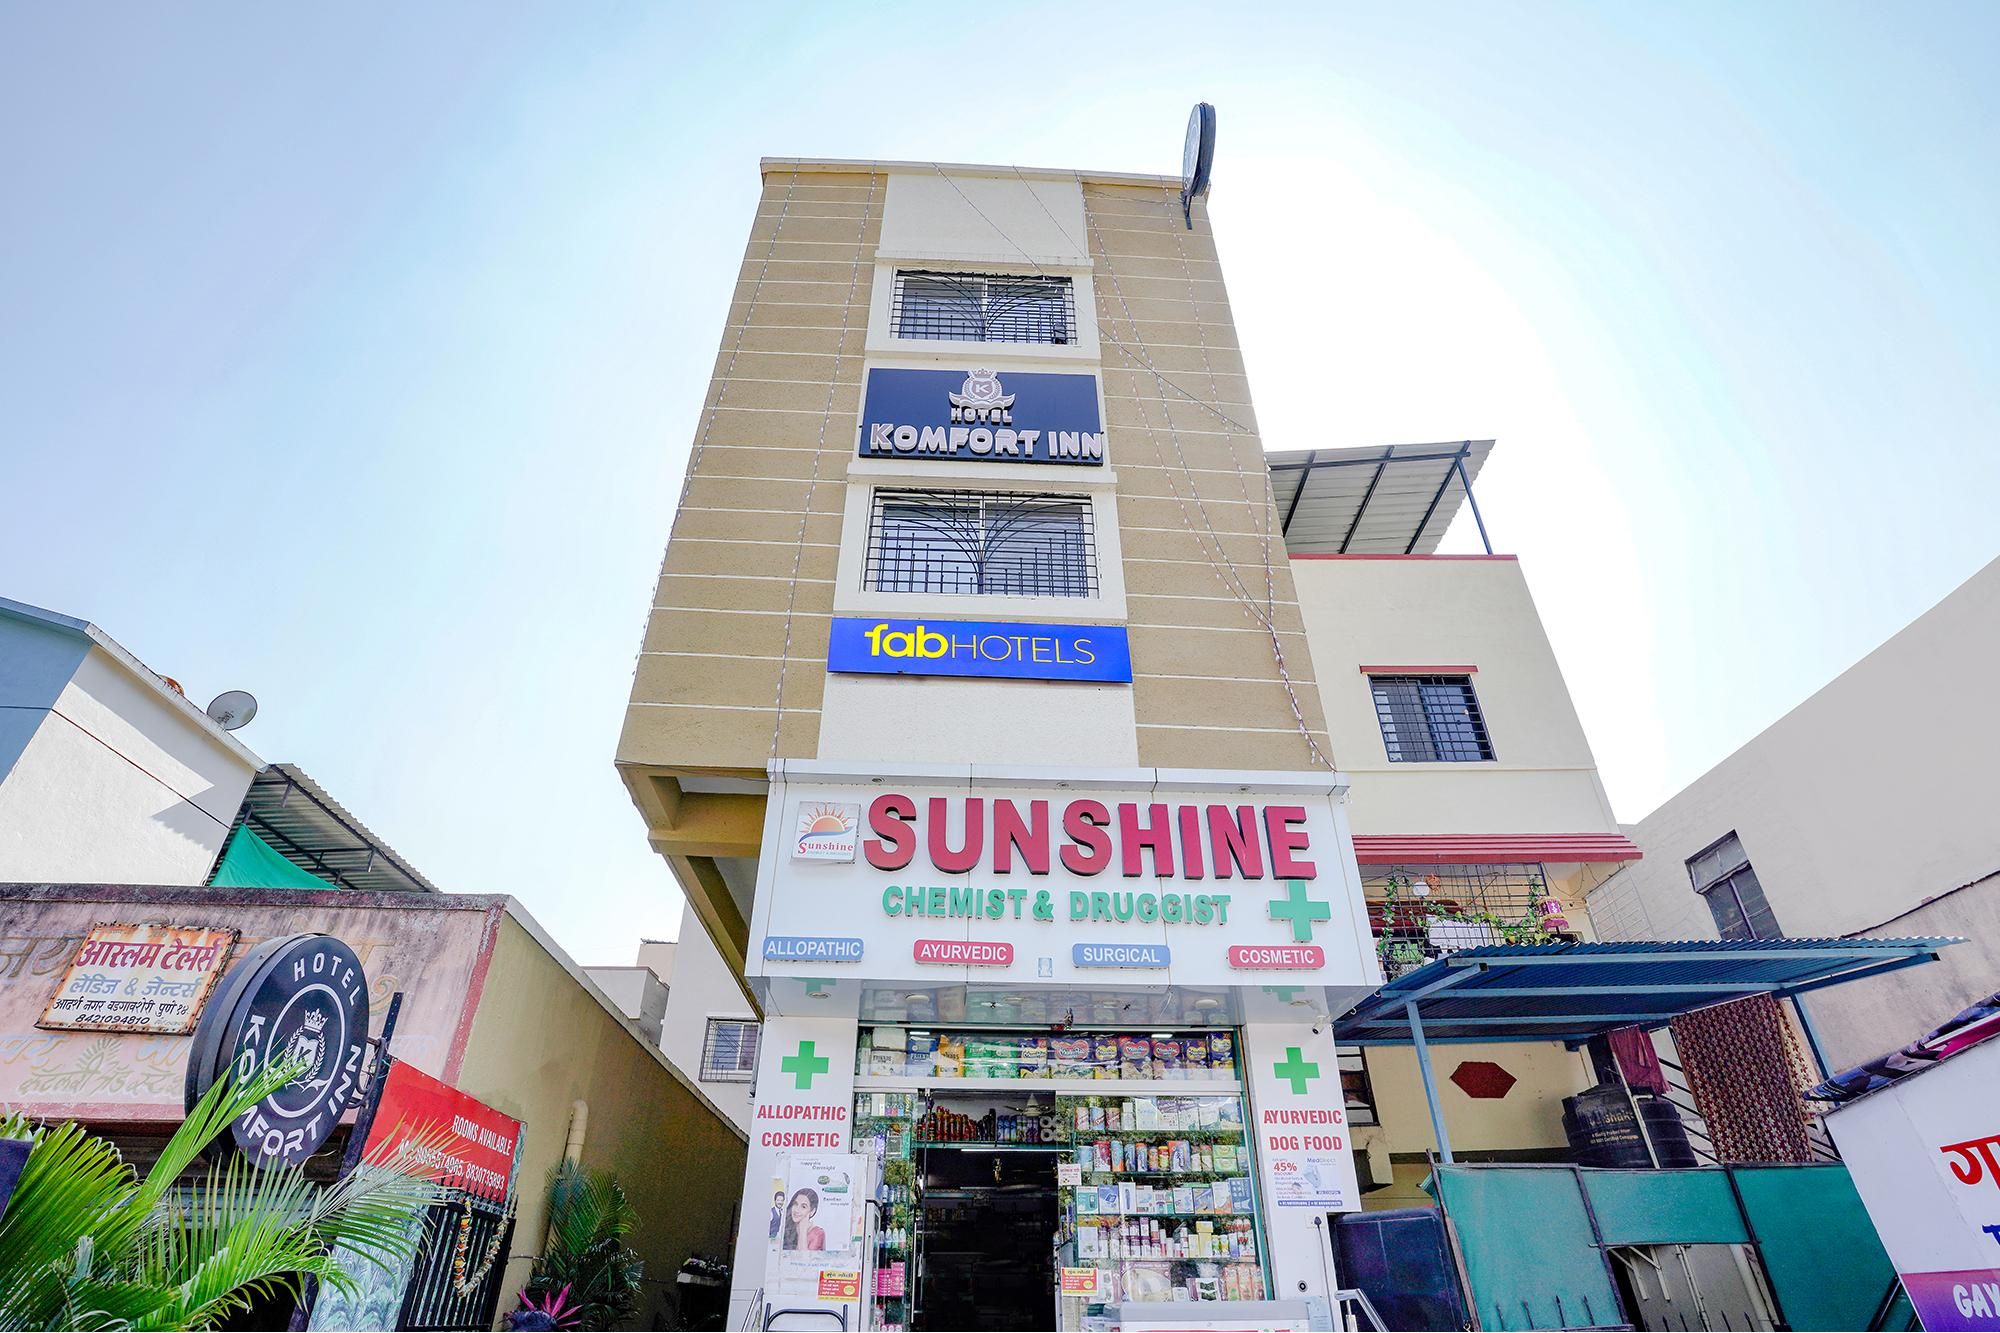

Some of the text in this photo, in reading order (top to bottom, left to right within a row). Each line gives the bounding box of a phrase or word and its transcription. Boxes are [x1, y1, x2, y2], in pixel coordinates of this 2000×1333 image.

[950, 407, 1013, 424] HOTEL
[870, 423, 1103, 458] KOMFORT INN
[863, 793, 1318, 880] SUNSHINE
[798, 842, 854, 854] Sunshine
[882, 885, 1232, 925] CHEMIST & DRUGGIST
[766, 941, 861, 957] ALLOPATHIC
[920, 944, 1008, 961] AYURVEDIC
[1083, 948, 1160, 963] SURGICAL
[1239, 950, 1315, 964] COSMETIC
[294, 953, 360, 1006] HOTEL
[75, 1014, 150, 1025] 8421094810
[328, 1045, 362, 1116] INN
[757, 1105, 846, 1120] ALLOPATHIC
[1264, 1110, 1342, 1124] AYURVEDIC
[451, 1114, 512, 1156] ROOMS AVAILABLE
[761, 1132, 840, 1147] COSMETIC
[1269, 1136, 1342, 1150] DOG FOOD
[1273, 1162, 1297, 1172] 45%
